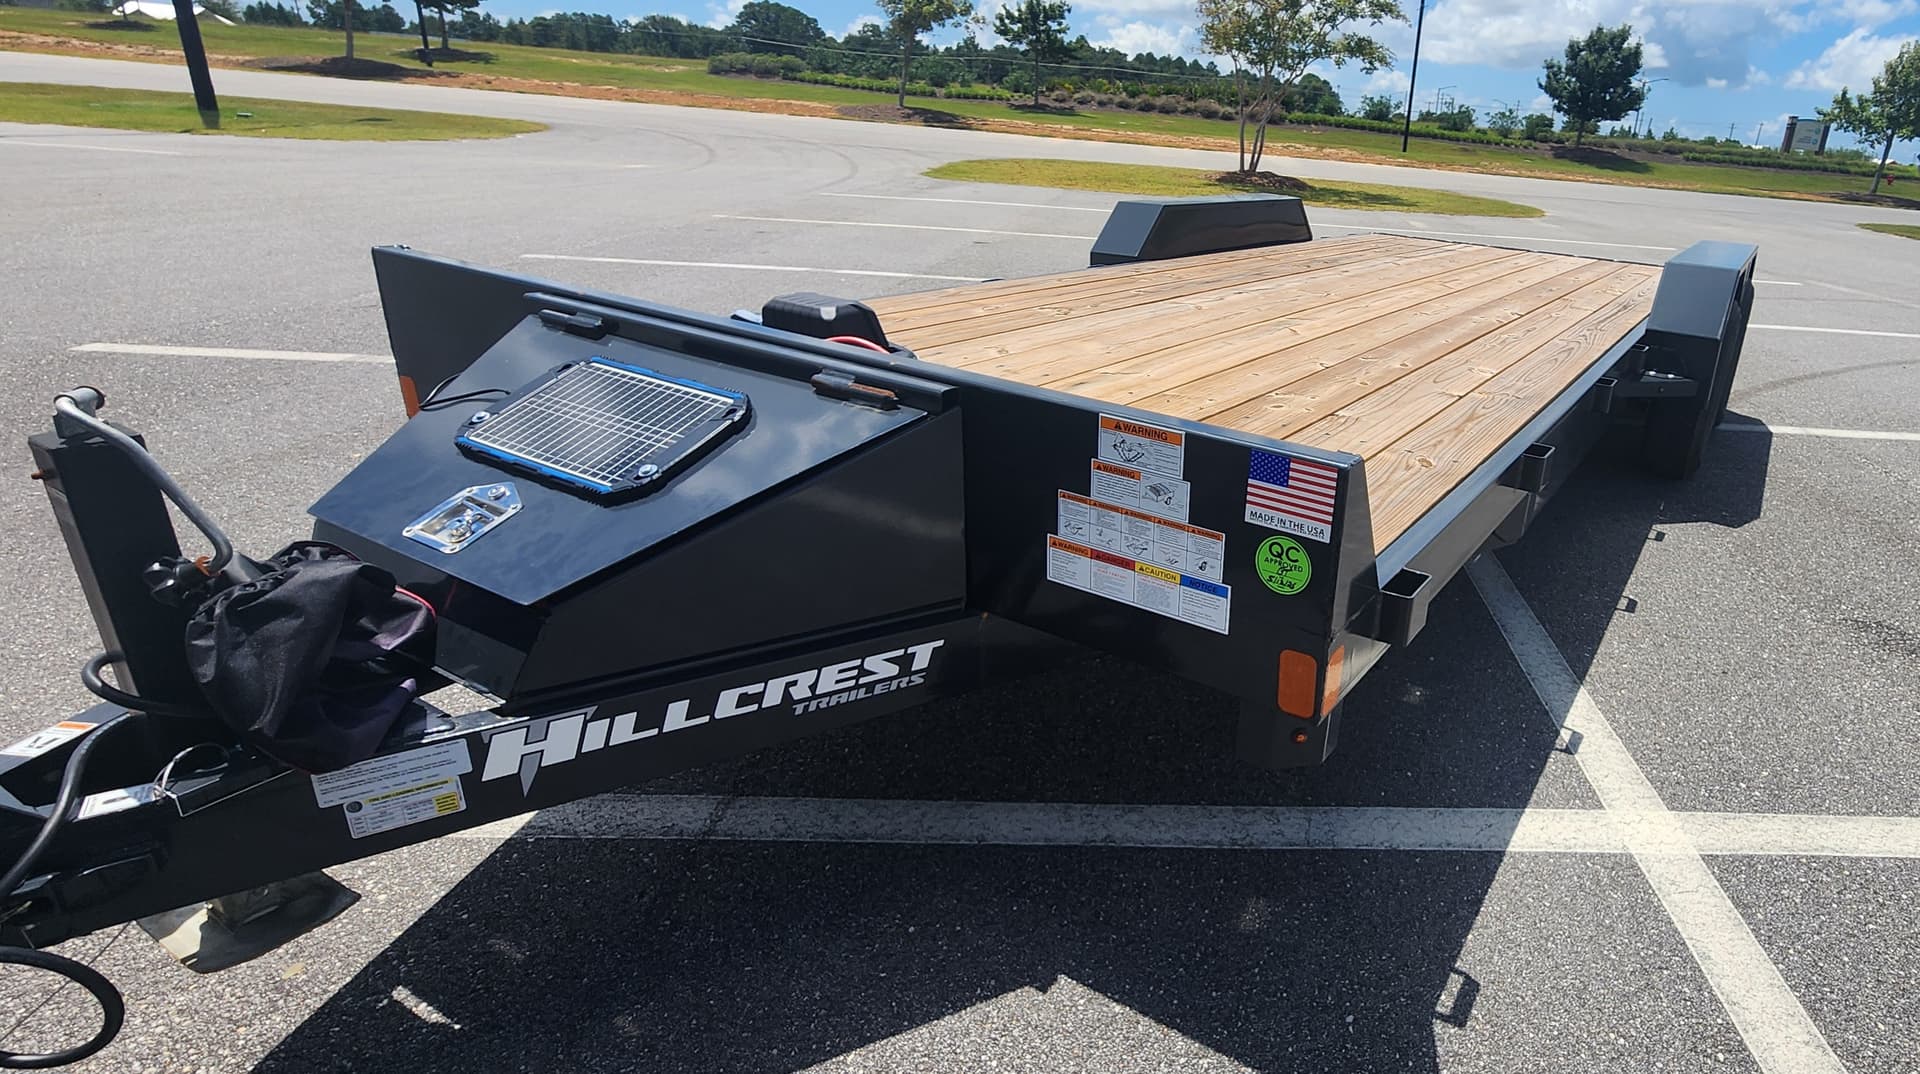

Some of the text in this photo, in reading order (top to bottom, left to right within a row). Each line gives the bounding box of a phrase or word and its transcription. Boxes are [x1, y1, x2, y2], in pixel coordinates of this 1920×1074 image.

[1121, 422, 1168, 441] WARNING
[1102, 464, 1136, 479] WARNING
[1249, 510, 1276, 523] MADE
[1277, 517, 1287, 527] IN
[1288, 520, 1305, 531] THE
[1306, 525, 1325, 537] USA
[1269, 541, 1301, 563] QC
[1144, 566, 1177, 582] CAUTION
[1264, 556, 1304, 573] APPROVED
[1189, 579, 1216, 593] NOTICE
[792, 672, 927, 716] TRAILERS
[481, 639, 945, 798] HILLCREST
